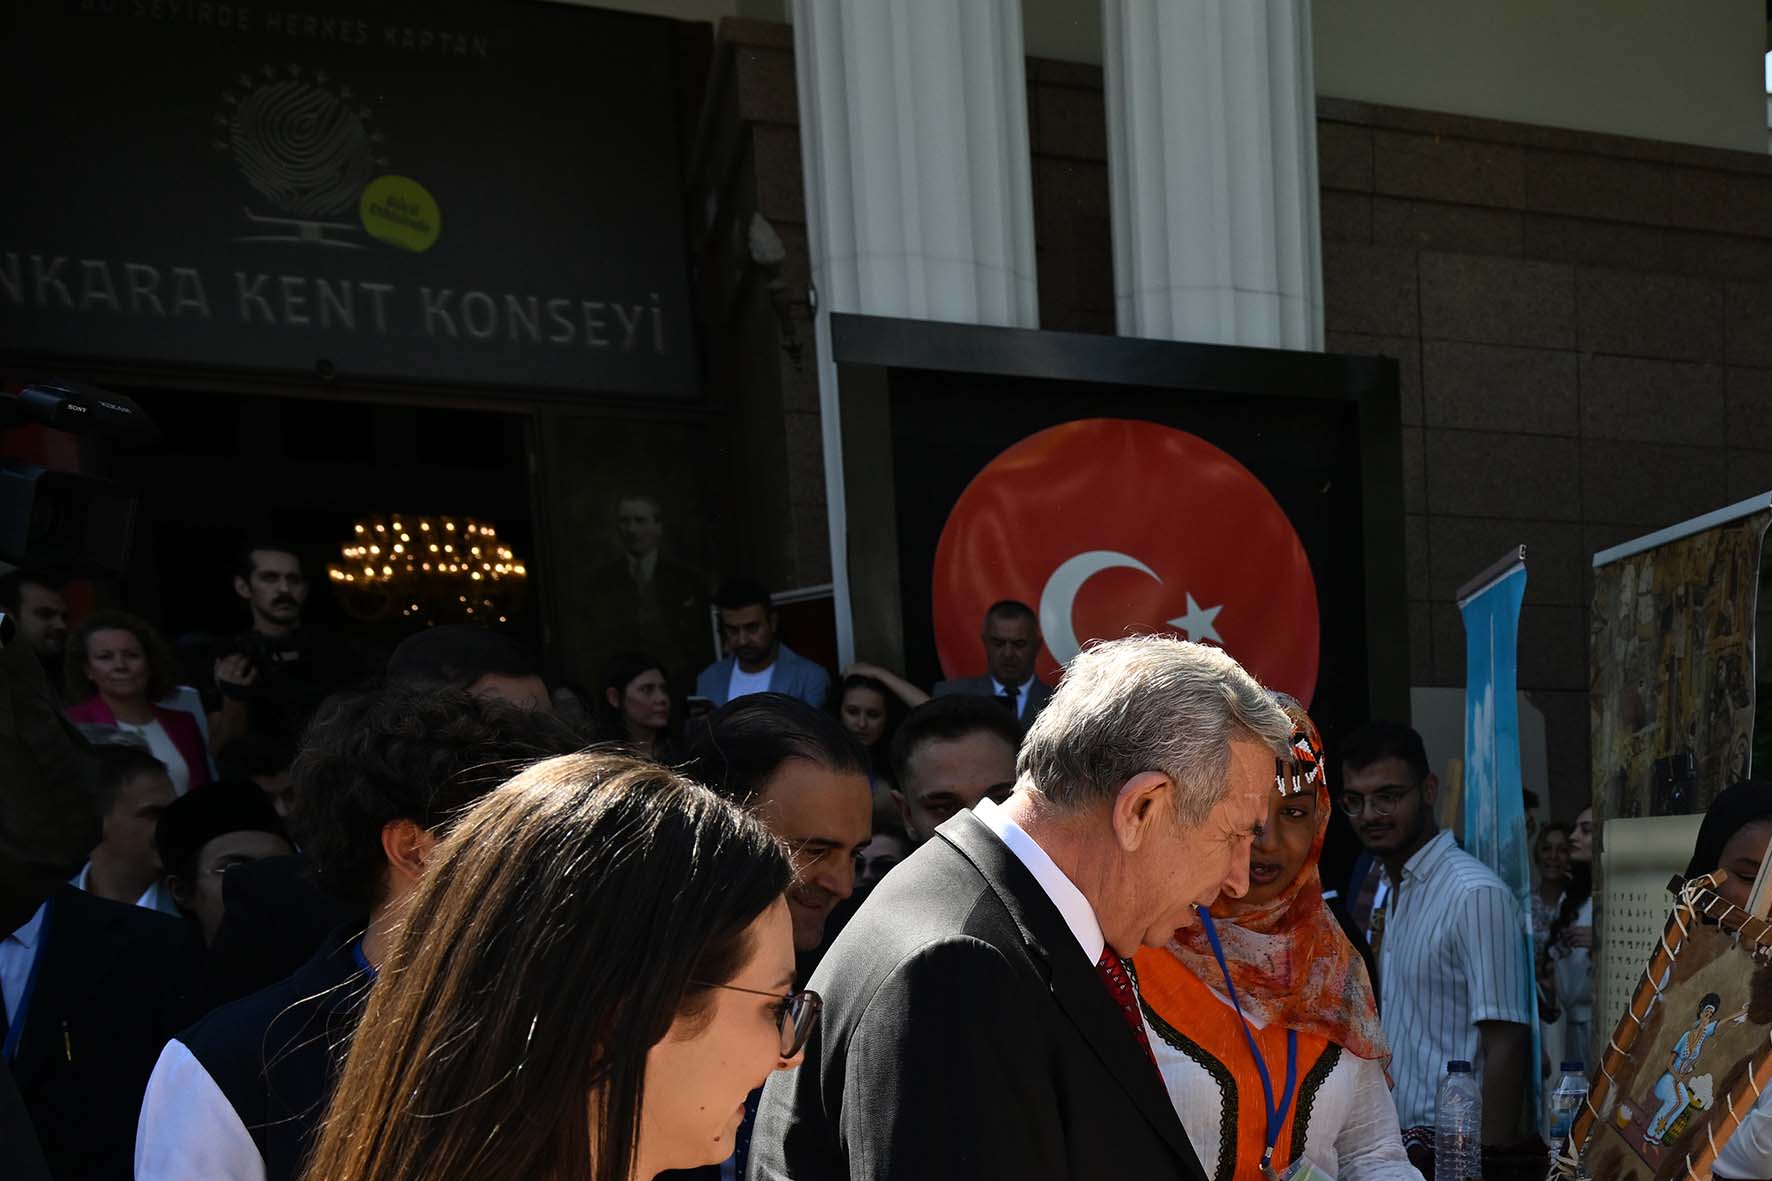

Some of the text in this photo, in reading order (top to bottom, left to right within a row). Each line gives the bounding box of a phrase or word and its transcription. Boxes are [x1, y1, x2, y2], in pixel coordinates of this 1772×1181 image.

[0, 252, 665, 355] NKARA KENT KONSEYİ
